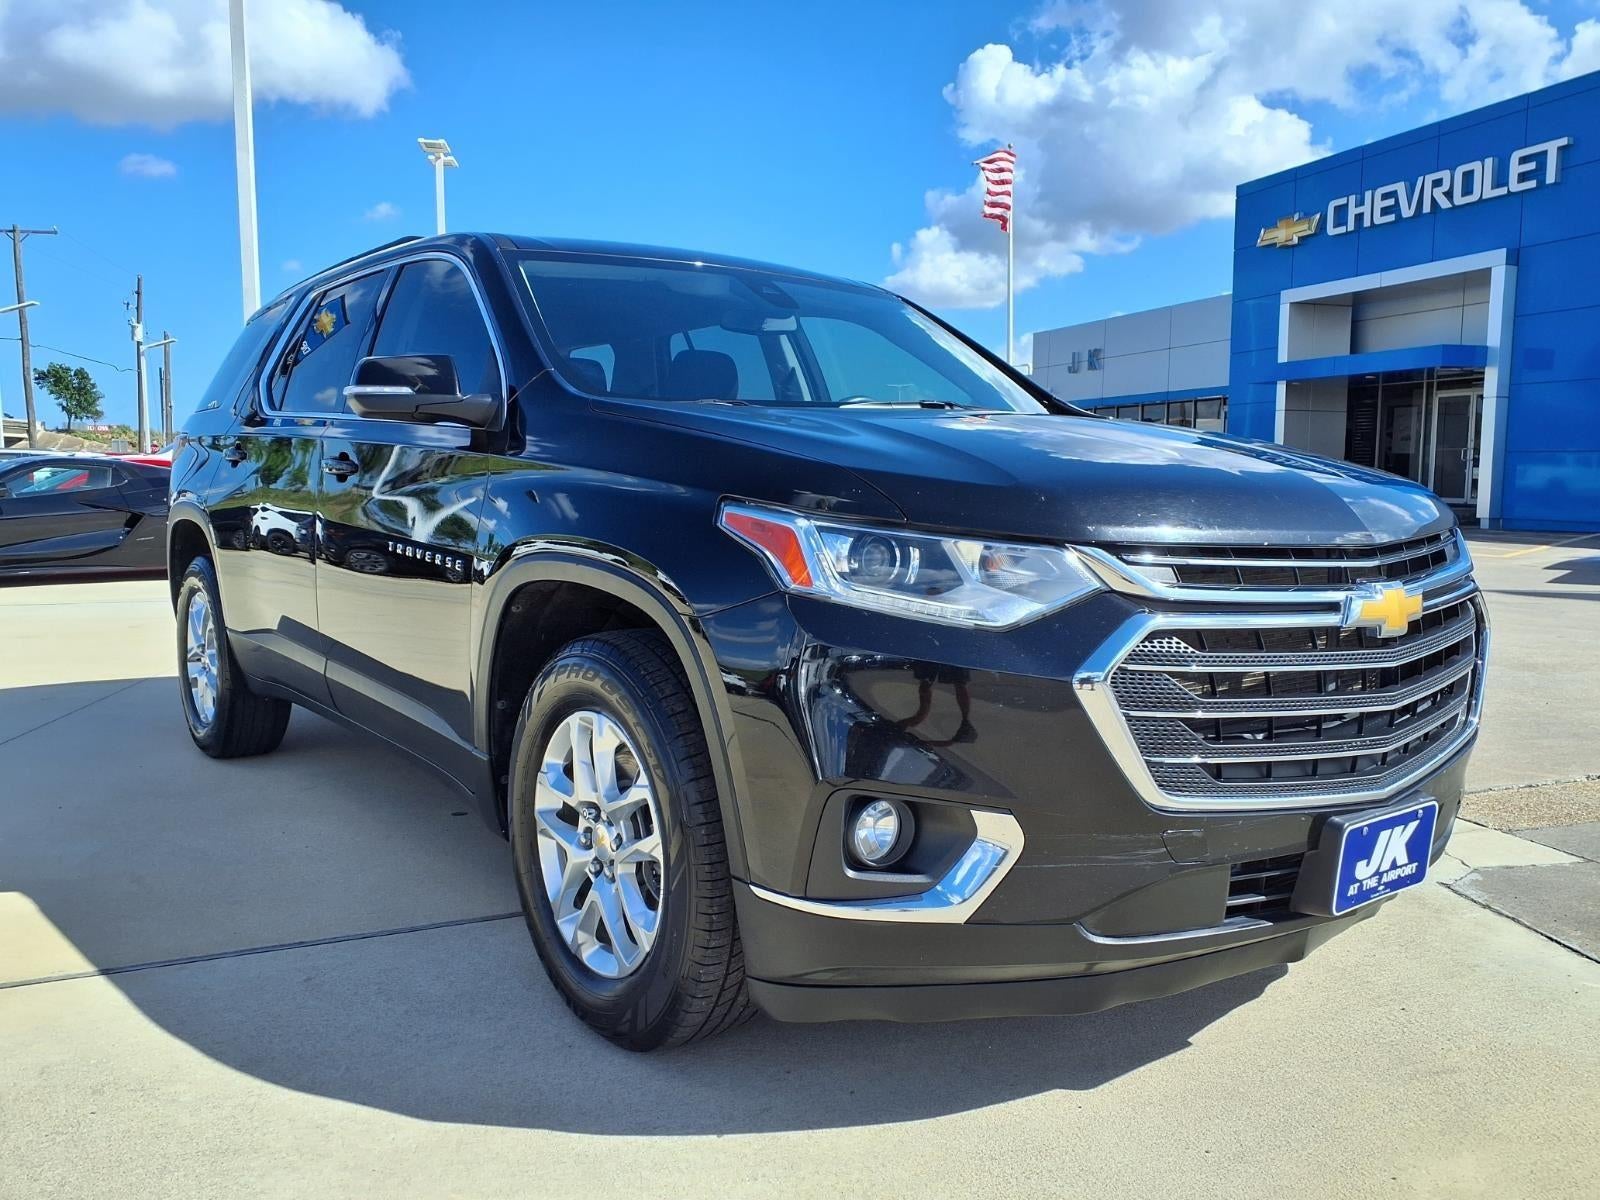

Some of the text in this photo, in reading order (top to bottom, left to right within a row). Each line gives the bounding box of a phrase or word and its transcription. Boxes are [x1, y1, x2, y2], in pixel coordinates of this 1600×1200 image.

[1326, 136, 1571, 236] CHEVROLET
[387, 541, 463, 571] TRAVERSE
[1355, 820, 1420, 880] JK
[1347, 882, 1360, 897] AT
[1362, 875, 1379, 891] THE
[1381, 862, 1419, 884] AIRPORT
